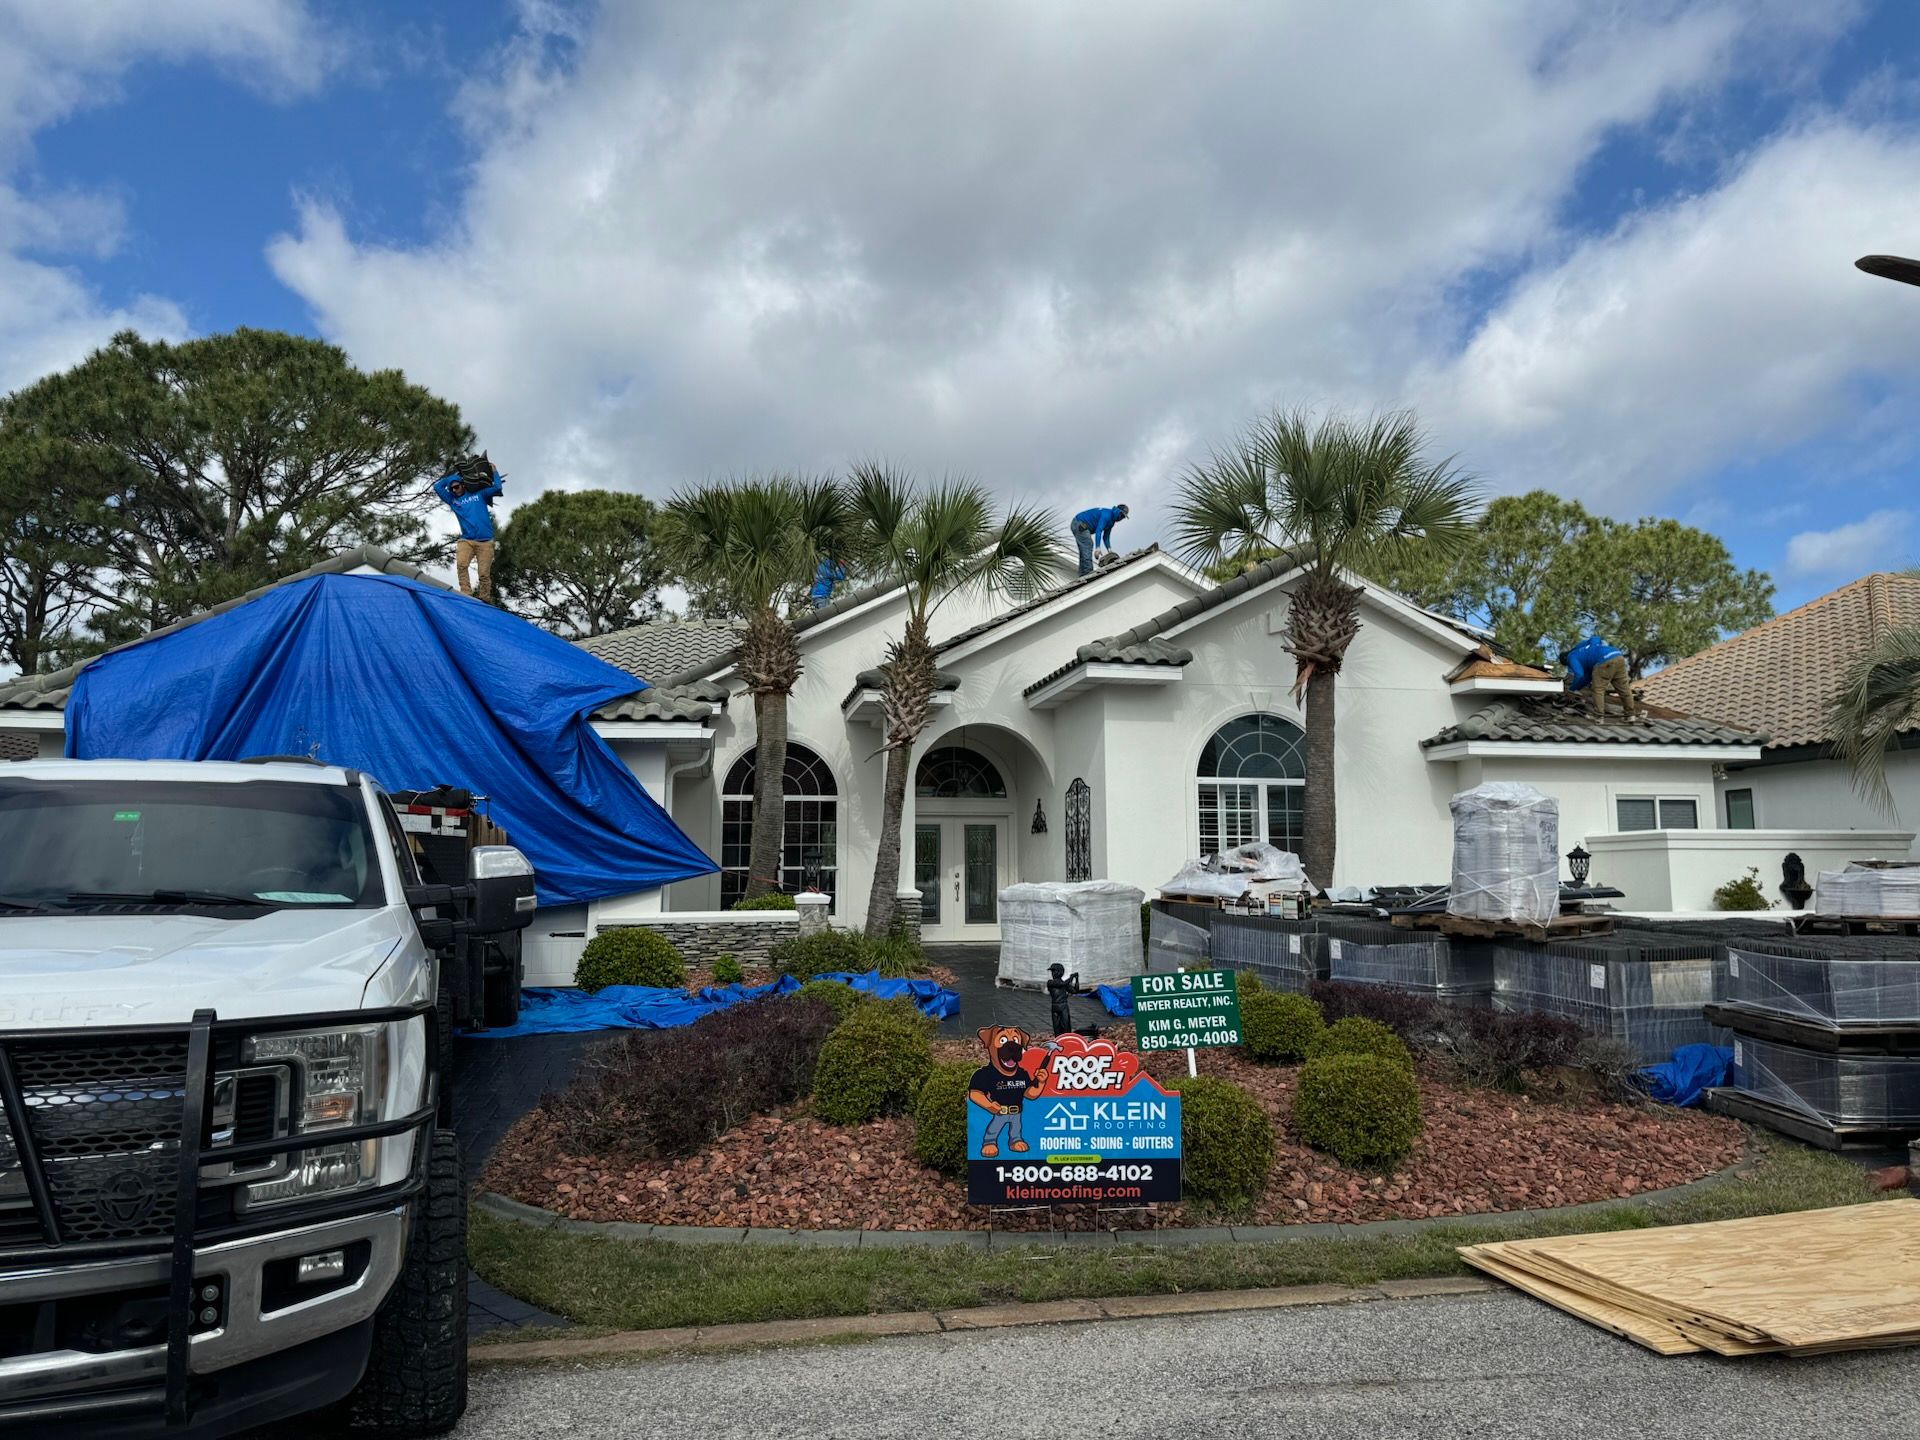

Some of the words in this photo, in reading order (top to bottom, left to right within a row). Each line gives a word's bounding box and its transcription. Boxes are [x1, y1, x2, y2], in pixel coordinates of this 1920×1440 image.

[1142, 976, 1175, 993] FOR
[1181, 973, 1224, 990] SALE
[1138, 1000, 1171, 1012] MEYER
[1173, 997, 1210, 1009] REALTY,
[1212, 996, 1233, 1006] INC.
[1148, 1019, 1171, 1031] KIM
[1173, 1019, 1185, 1029] G.
[1188, 1016, 1227, 1028] MEYER
[1141, 1030, 1238, 1049] 850-420-4008
[1052, 1056, 1113, 1073] ROOF
[1057, 1072, 1124, 1089] ROOF!
[1093, 1102, 1166, 1120] KLEIN
[1093, 1121, 1166, 1130] ROOFING
[1040, 1137, 1081, 1150] ROOFING
[1090, 1137, 1123, 1149] SIDING
[1132, 1136, 1174, 1150] GUTTERS
[996, 1165, 1153, 1182] 1-800-688-4102
[1006, 1185, 1141, 1200] kleinroofing.com
